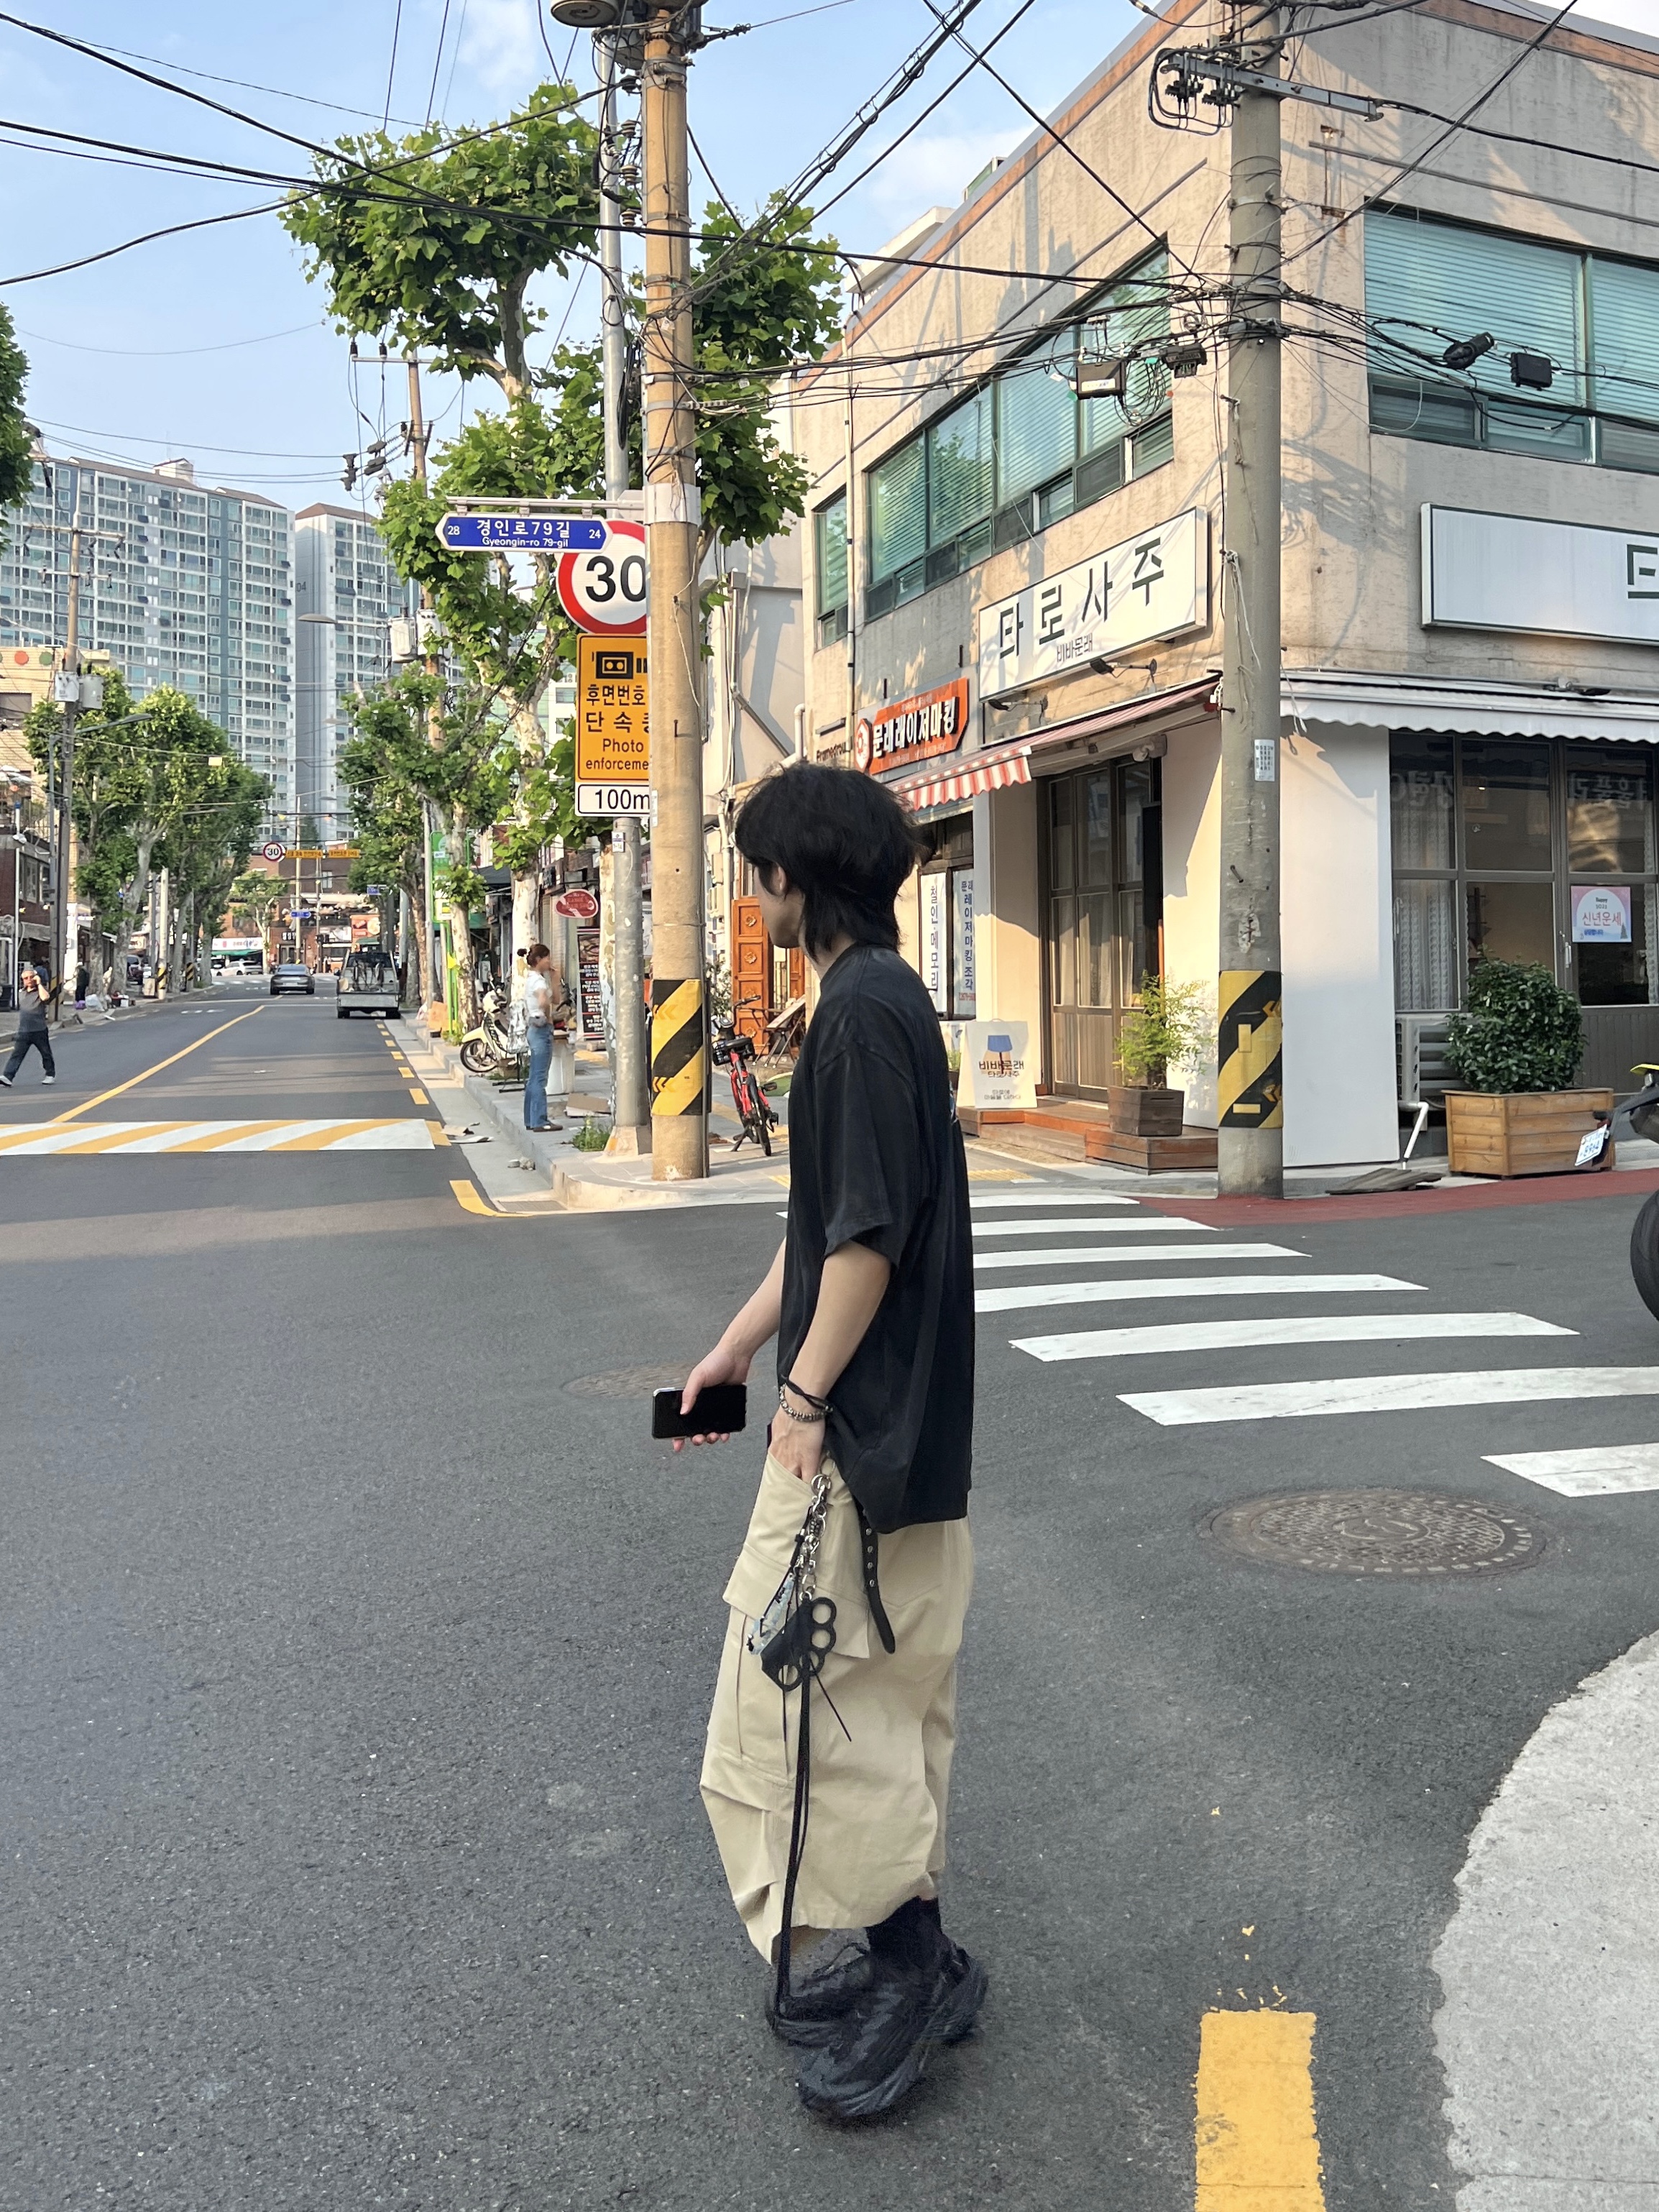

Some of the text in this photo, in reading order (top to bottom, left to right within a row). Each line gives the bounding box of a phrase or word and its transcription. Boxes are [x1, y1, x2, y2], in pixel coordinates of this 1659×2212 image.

[447, 519, 602, 539] 28 경인로79길 24
[482, 537, 569, 549] Gyeongin-ro 79-gil
[585, 555, 646, 602] 30
[1000, 536, 1164, 659] 타로사주
[873, 696, 957, 758] 문래레이저마킹
[602, 738, 644, 753] Photo
[594, 789, 650, 810] 100m
[267, 848, 280, 856] 30
[1582, 911, 1622, 927] 신년운세
